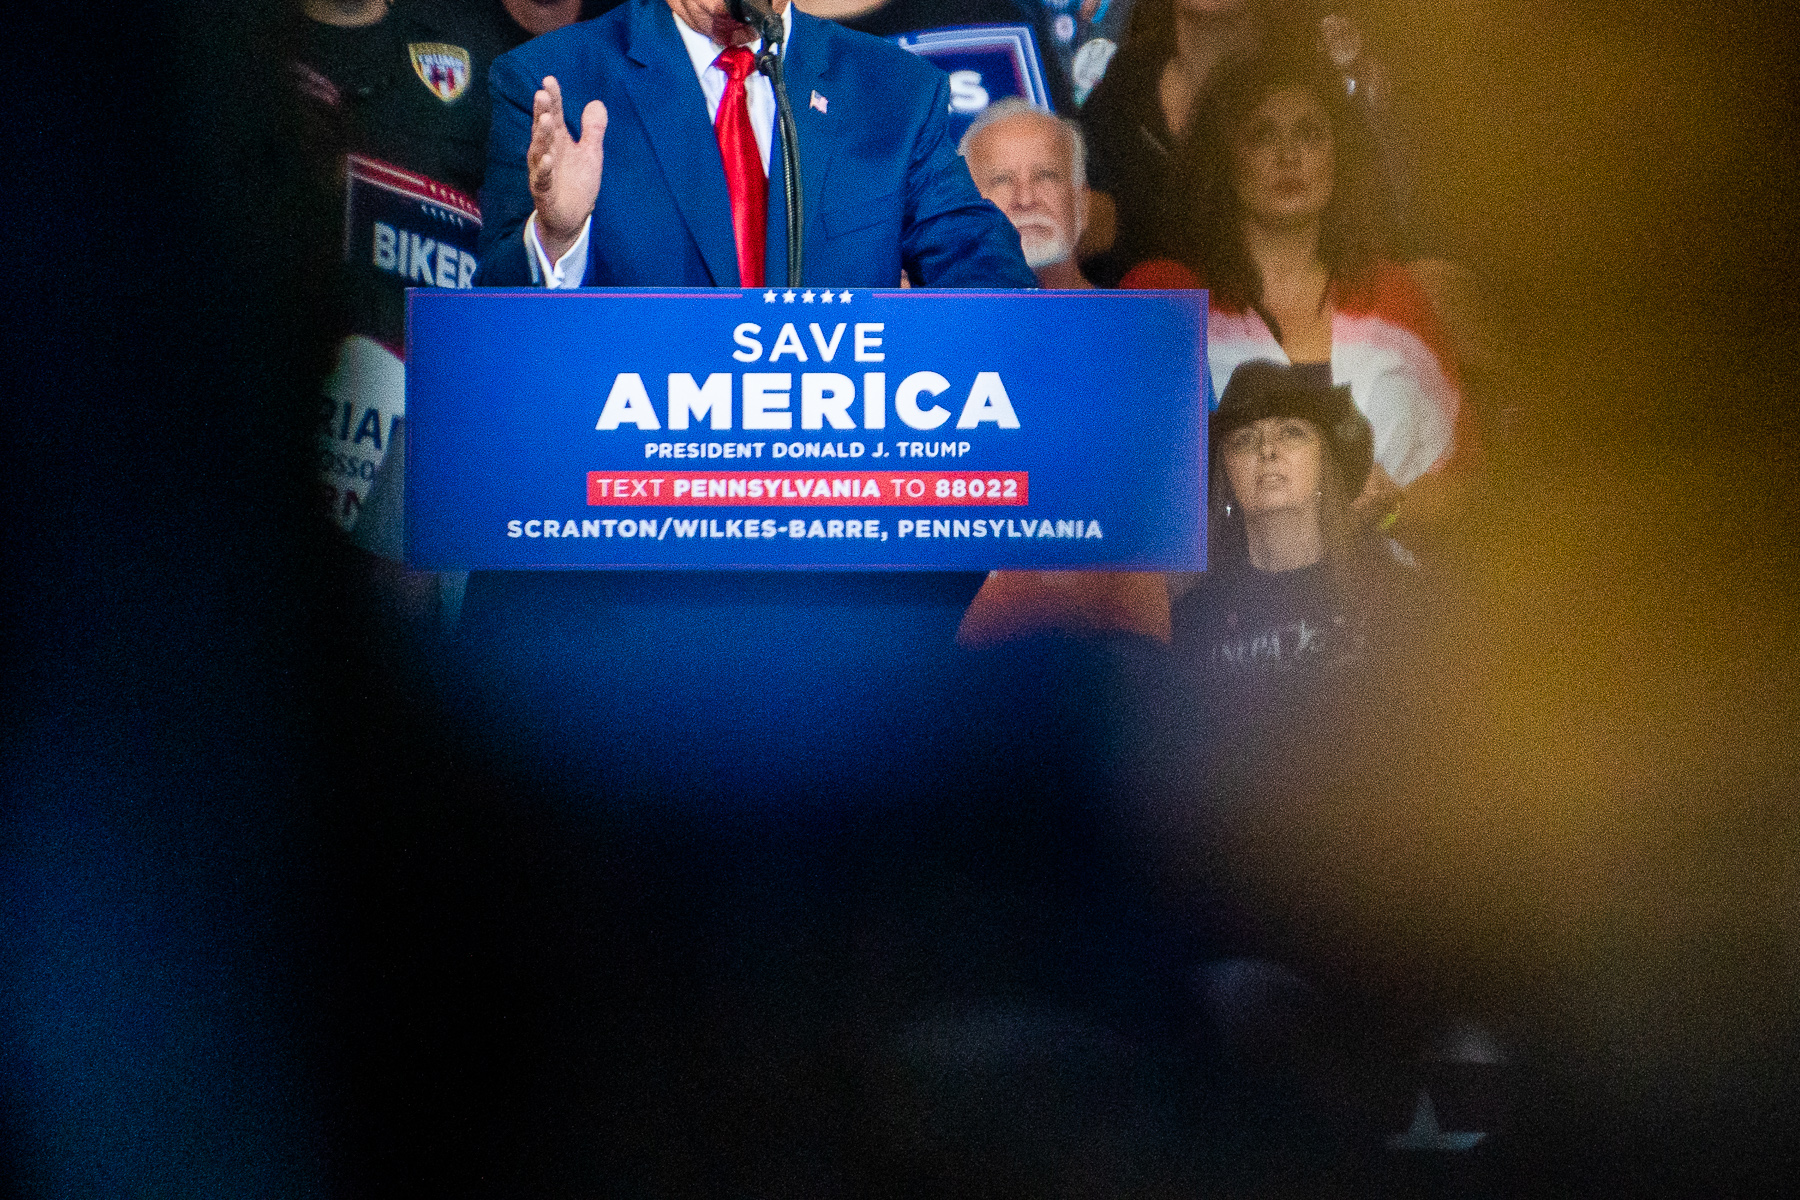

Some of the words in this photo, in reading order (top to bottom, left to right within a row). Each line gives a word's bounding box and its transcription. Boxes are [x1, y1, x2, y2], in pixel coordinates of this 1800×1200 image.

[732, 322, 886, 362] SAVE
[595, 371, 1021, 430] AMERICA
[645, 441, 765, 459] PRESIDENT
[772, 441, 865, 459] DONALD
[872, 441, 890, 459] J.
[897, 441, 971, 458] TRUMP
[597, 479, 665, 497] TEXT
[673, 479, 881, 498] PENNSYLVANIA
[891, 479, 925, 497] TO
[935, 479, 1018, 498] 88022
[506, 518, 889, 541] SCRANTON/WILKES-BARRE,
[898, 519, 1104, 539] PENNSYLVANIA
